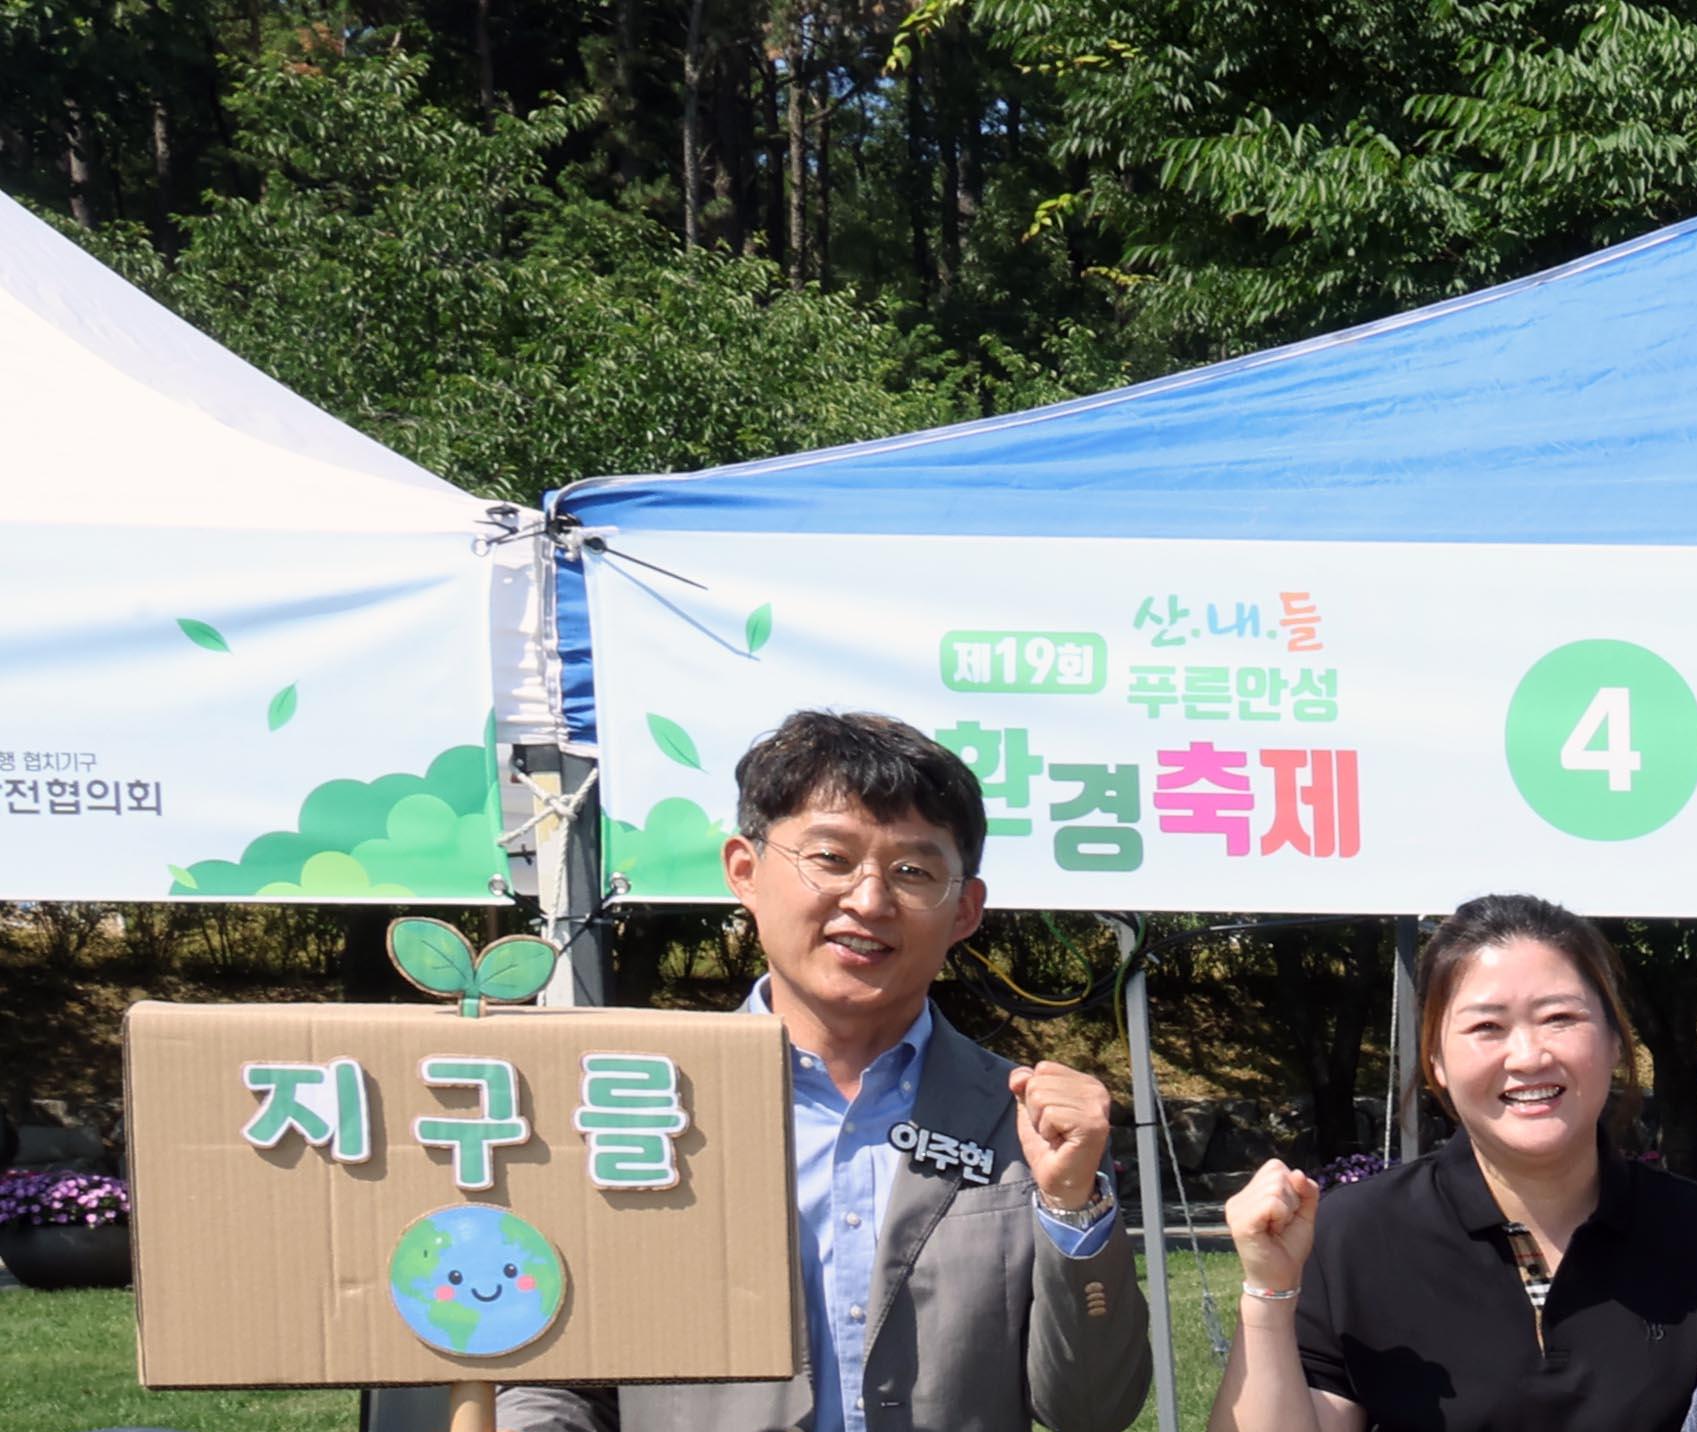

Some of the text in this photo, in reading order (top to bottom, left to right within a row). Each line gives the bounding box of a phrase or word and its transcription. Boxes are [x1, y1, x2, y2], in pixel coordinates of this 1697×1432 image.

[952, 636, 1094, 686] 제19회
[23, 751, 98, 773] 협치기구
[1559, 686, 1642, 792] 4
[0, 778, 162, 817] 전협의회
[241, 1050, 689, 1191] 지구를
[890, 1121, 995, 1185] 이주현
